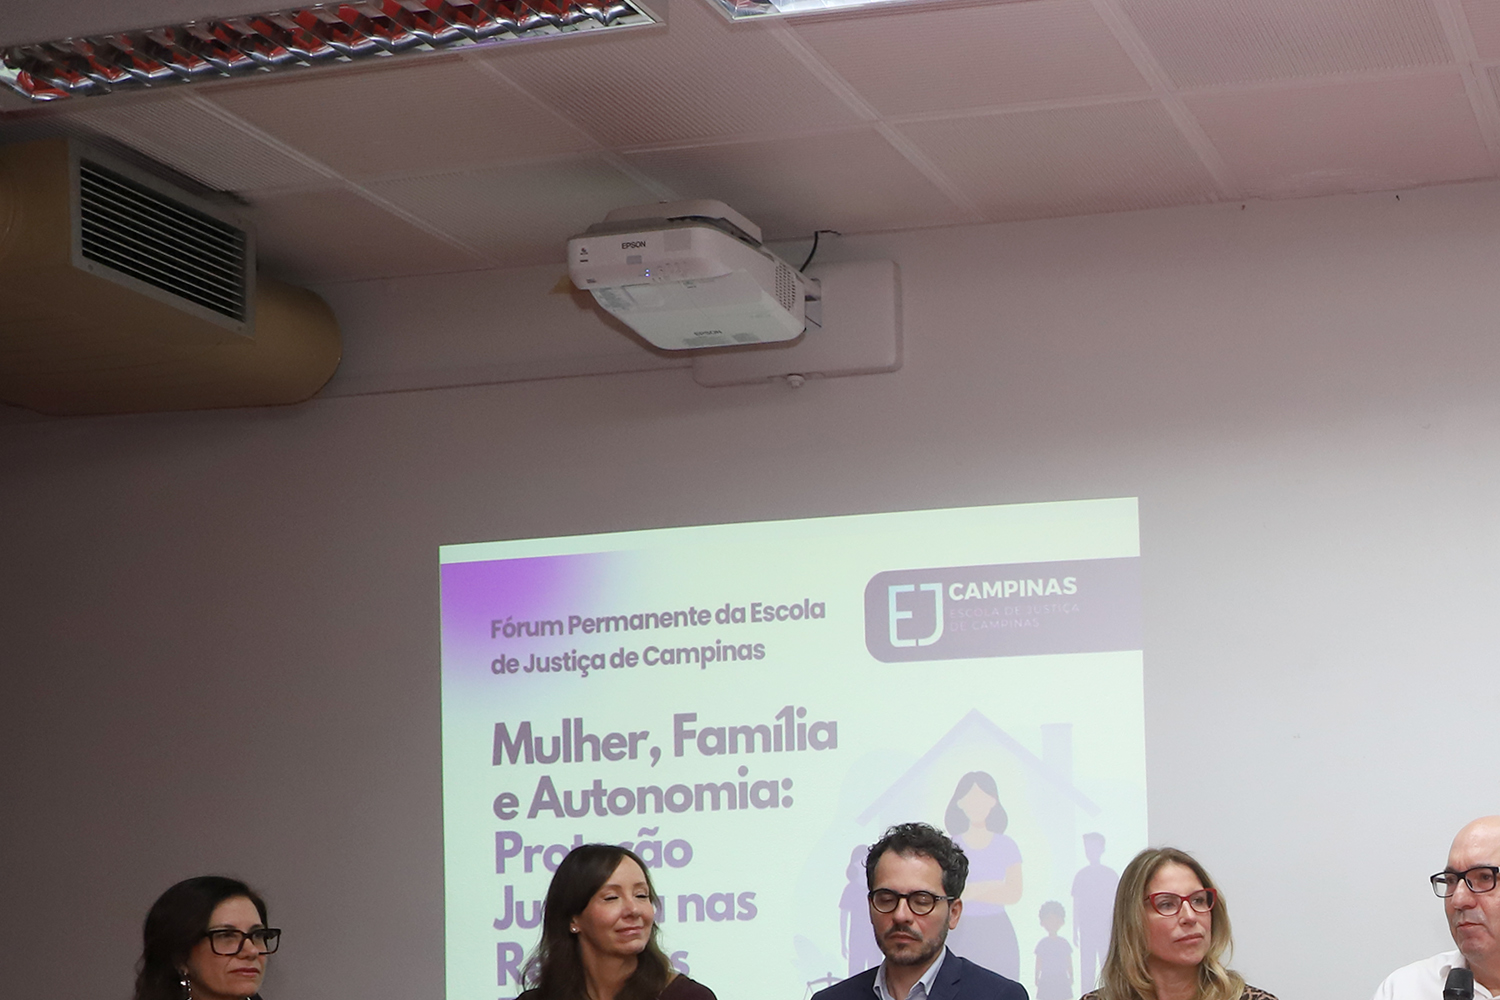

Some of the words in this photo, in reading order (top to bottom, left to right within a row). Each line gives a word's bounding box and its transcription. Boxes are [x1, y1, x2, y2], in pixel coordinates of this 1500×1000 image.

[621, 241, 646, 249] EPSON
[948, 576, 1078, 601] CAMPINAS
[490, 613, 564, 640] Fórum
[567, 605, 711, 637] Permanente
[715, 604, 747, 626] da
[750, 598, 827, 624] Escola
[972, 618, 1040, 630] CAMPINAS
[490, 652, 520, 675] de
[522, 648, 605, 678] Justiça
[609, 645, 639, 668] de
[642, 639, 766, 669] Campinas
[491, 717, 663, 768] Mulher,
[673, 704, 839, 759] Família
[493, 791, 520, 821] e
[526, 766, 795, 822] Autonomia:
[494, 826, 693, 874] Proão
[677, 891, 758, 924] nas
